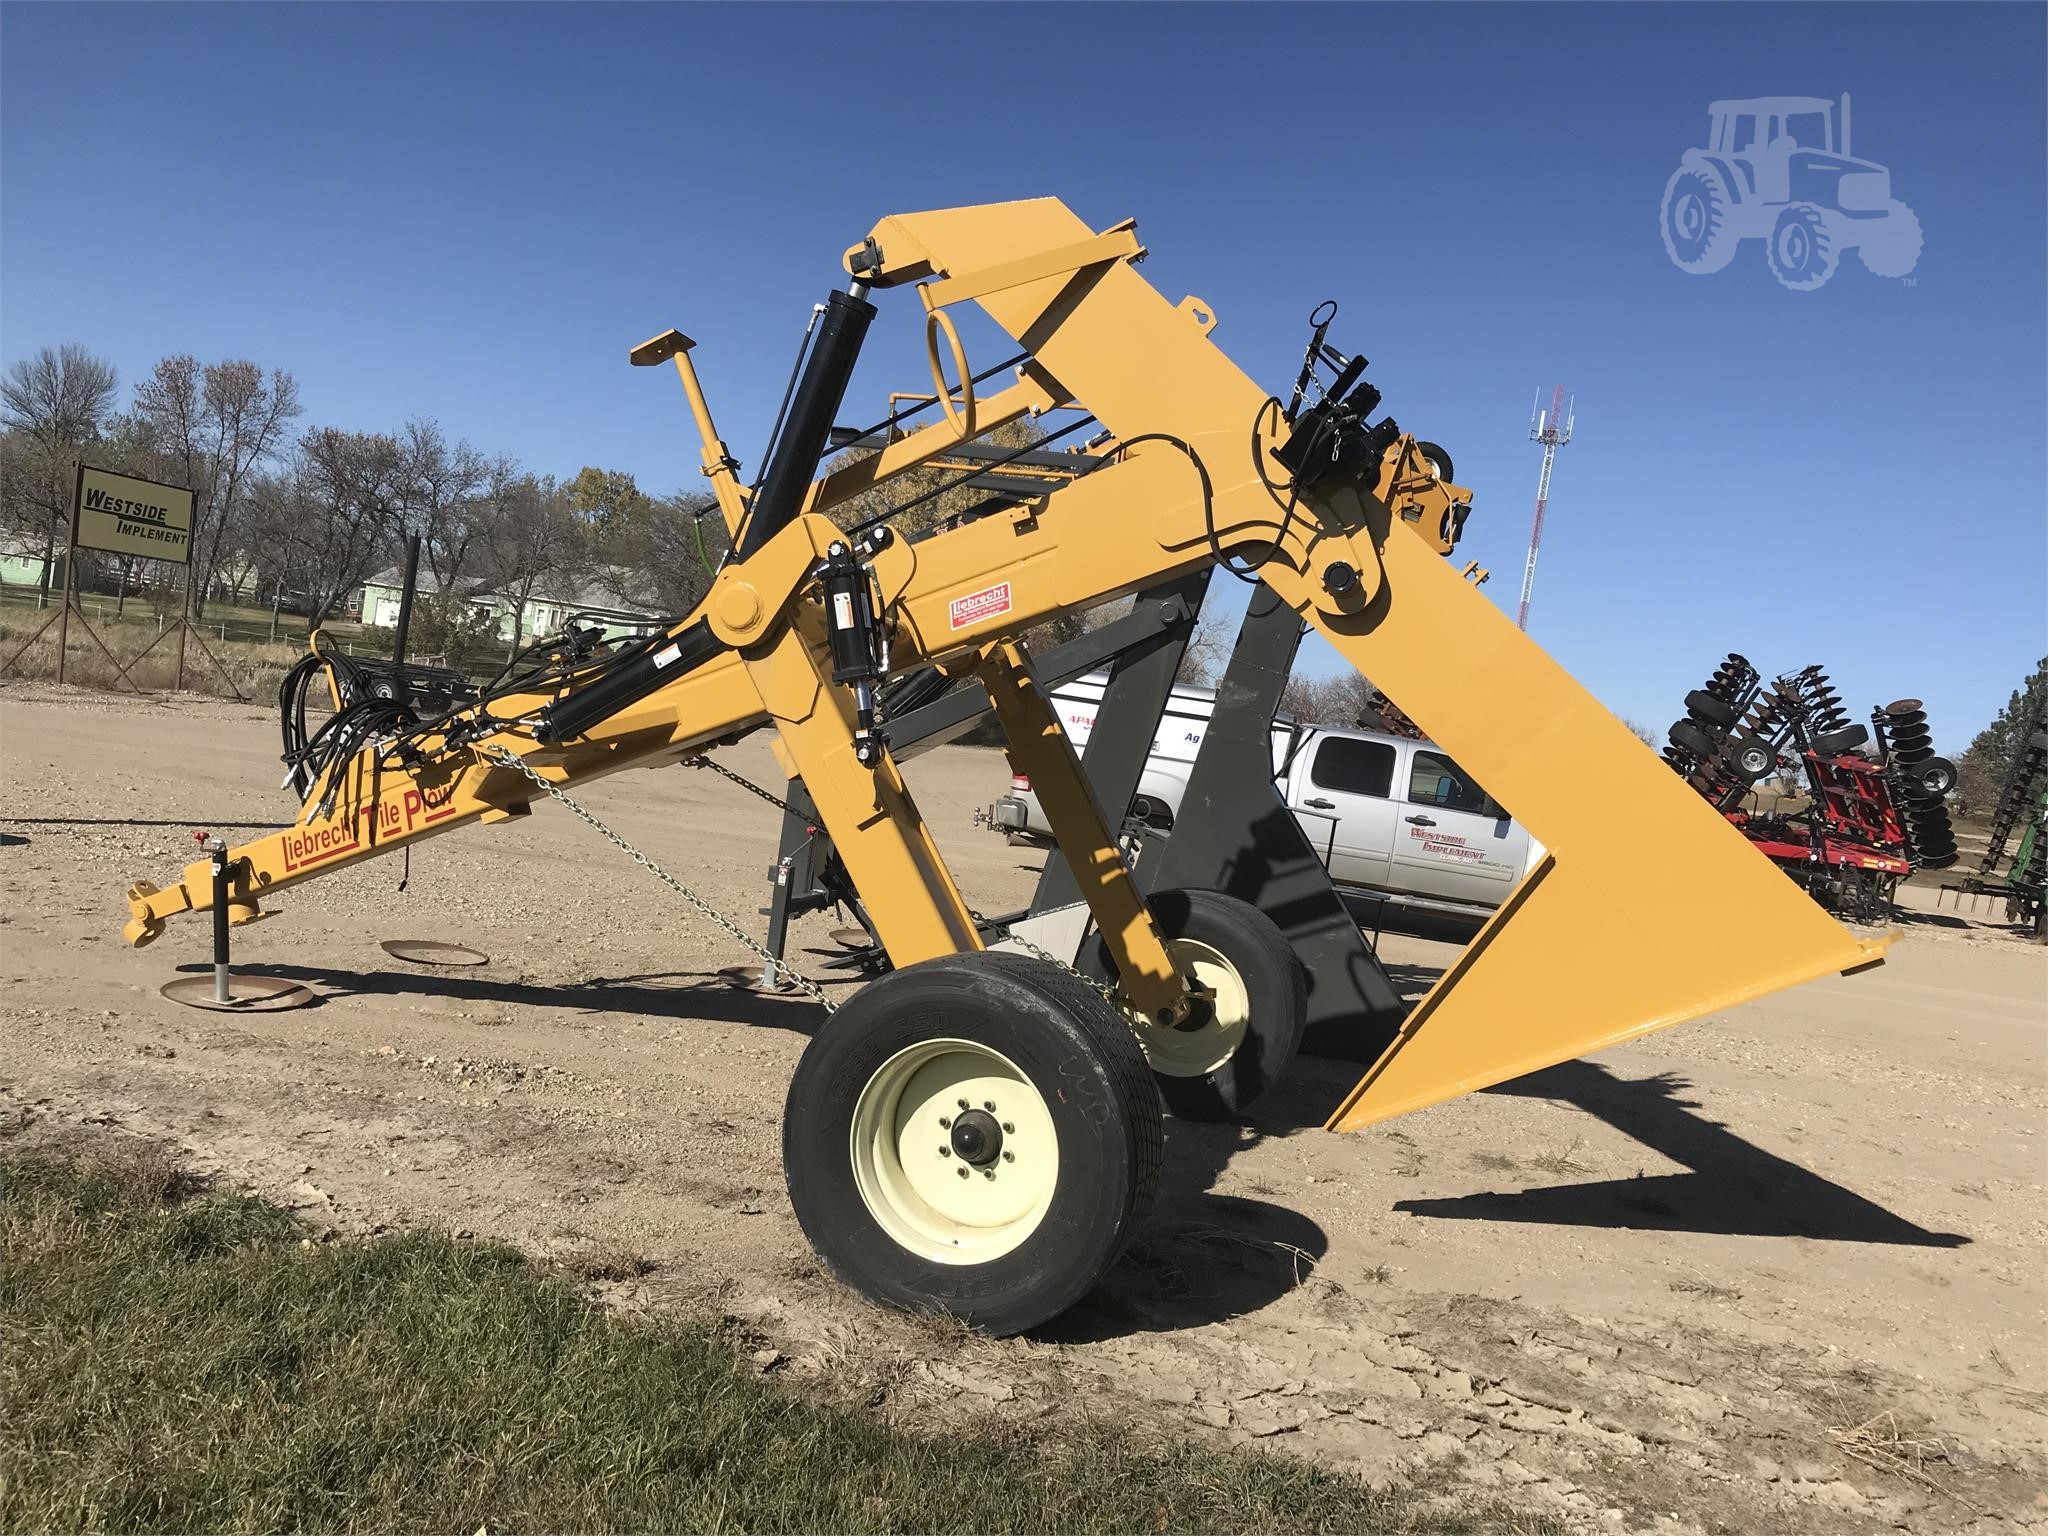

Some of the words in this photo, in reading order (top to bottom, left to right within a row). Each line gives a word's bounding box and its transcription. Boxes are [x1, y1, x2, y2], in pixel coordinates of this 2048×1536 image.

[86, 488, 168, 521] WESTSIDE
[116, 520, 188, 545] IMPLEMENT
[1184, 732, 1200, 743] Ag
